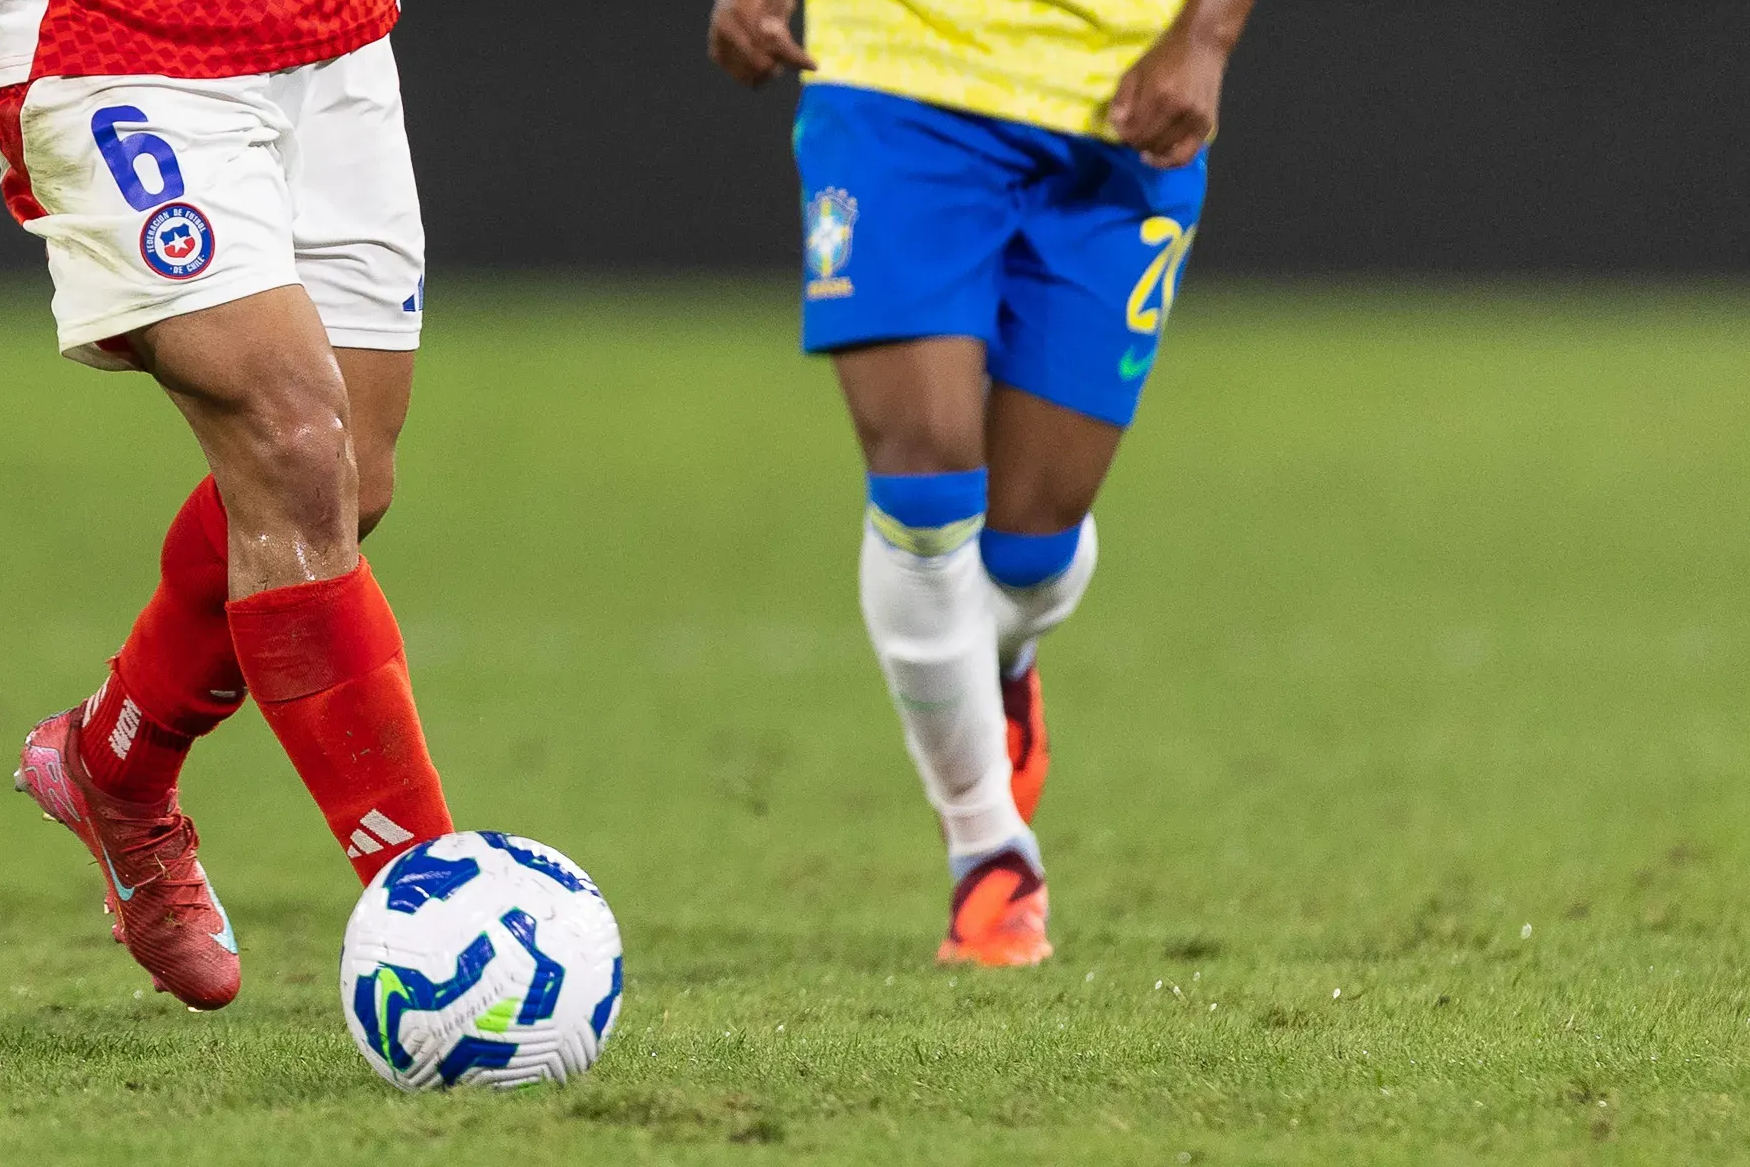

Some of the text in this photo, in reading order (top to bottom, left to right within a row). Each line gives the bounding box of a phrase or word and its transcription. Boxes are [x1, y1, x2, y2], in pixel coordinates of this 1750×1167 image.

[91, 105, 185, 212] 6
[147, 211, 170, 253] FEDERACION
[185, 211, 207, 233] FUTBOL
[173, 256, 205, 274] DE CHILE
